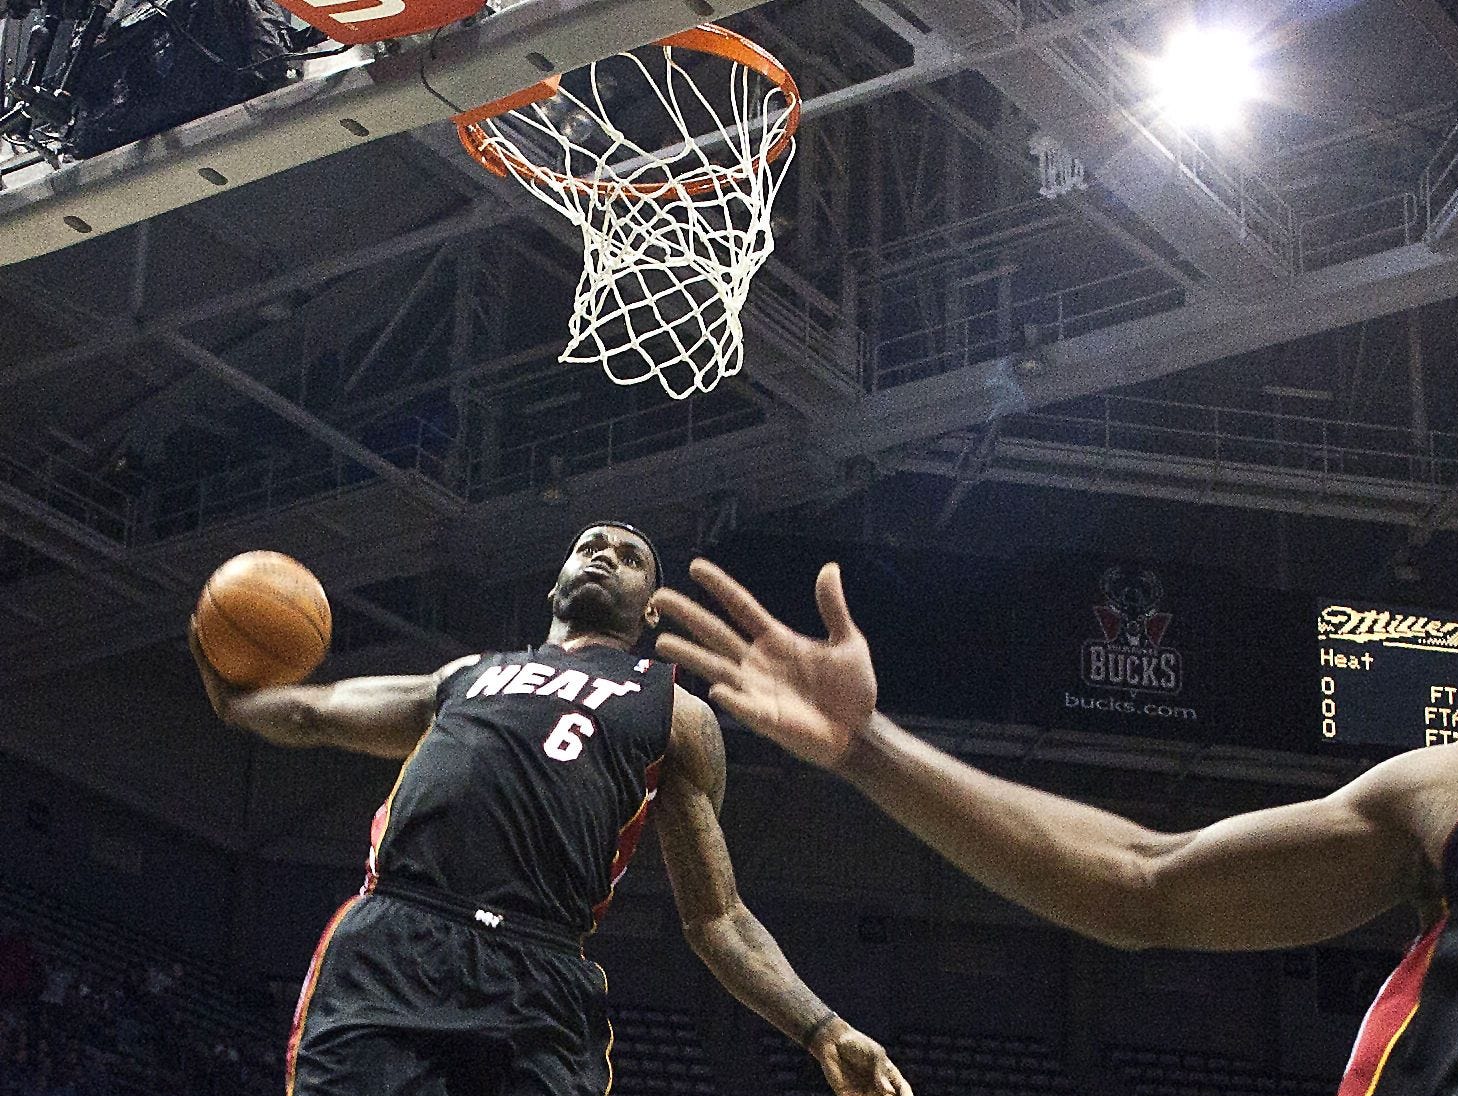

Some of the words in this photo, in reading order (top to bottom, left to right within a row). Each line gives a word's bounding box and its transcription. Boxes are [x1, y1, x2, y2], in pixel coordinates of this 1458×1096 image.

[1089, 645, 1176, 689] BUCKS
[1320, 648, 1374, 671] Heat
[466, 661, 642, 711] HEAT
[1321, 676, 1335, 695] 0
[1430, 686, 1457, 705] FT
[1064, 691, 1198, 720] bucks.com
[1322, 698, 1336, 718] 0
[542, 710, 598, 763] 6
[1322, 718, 1337, 738] 0
